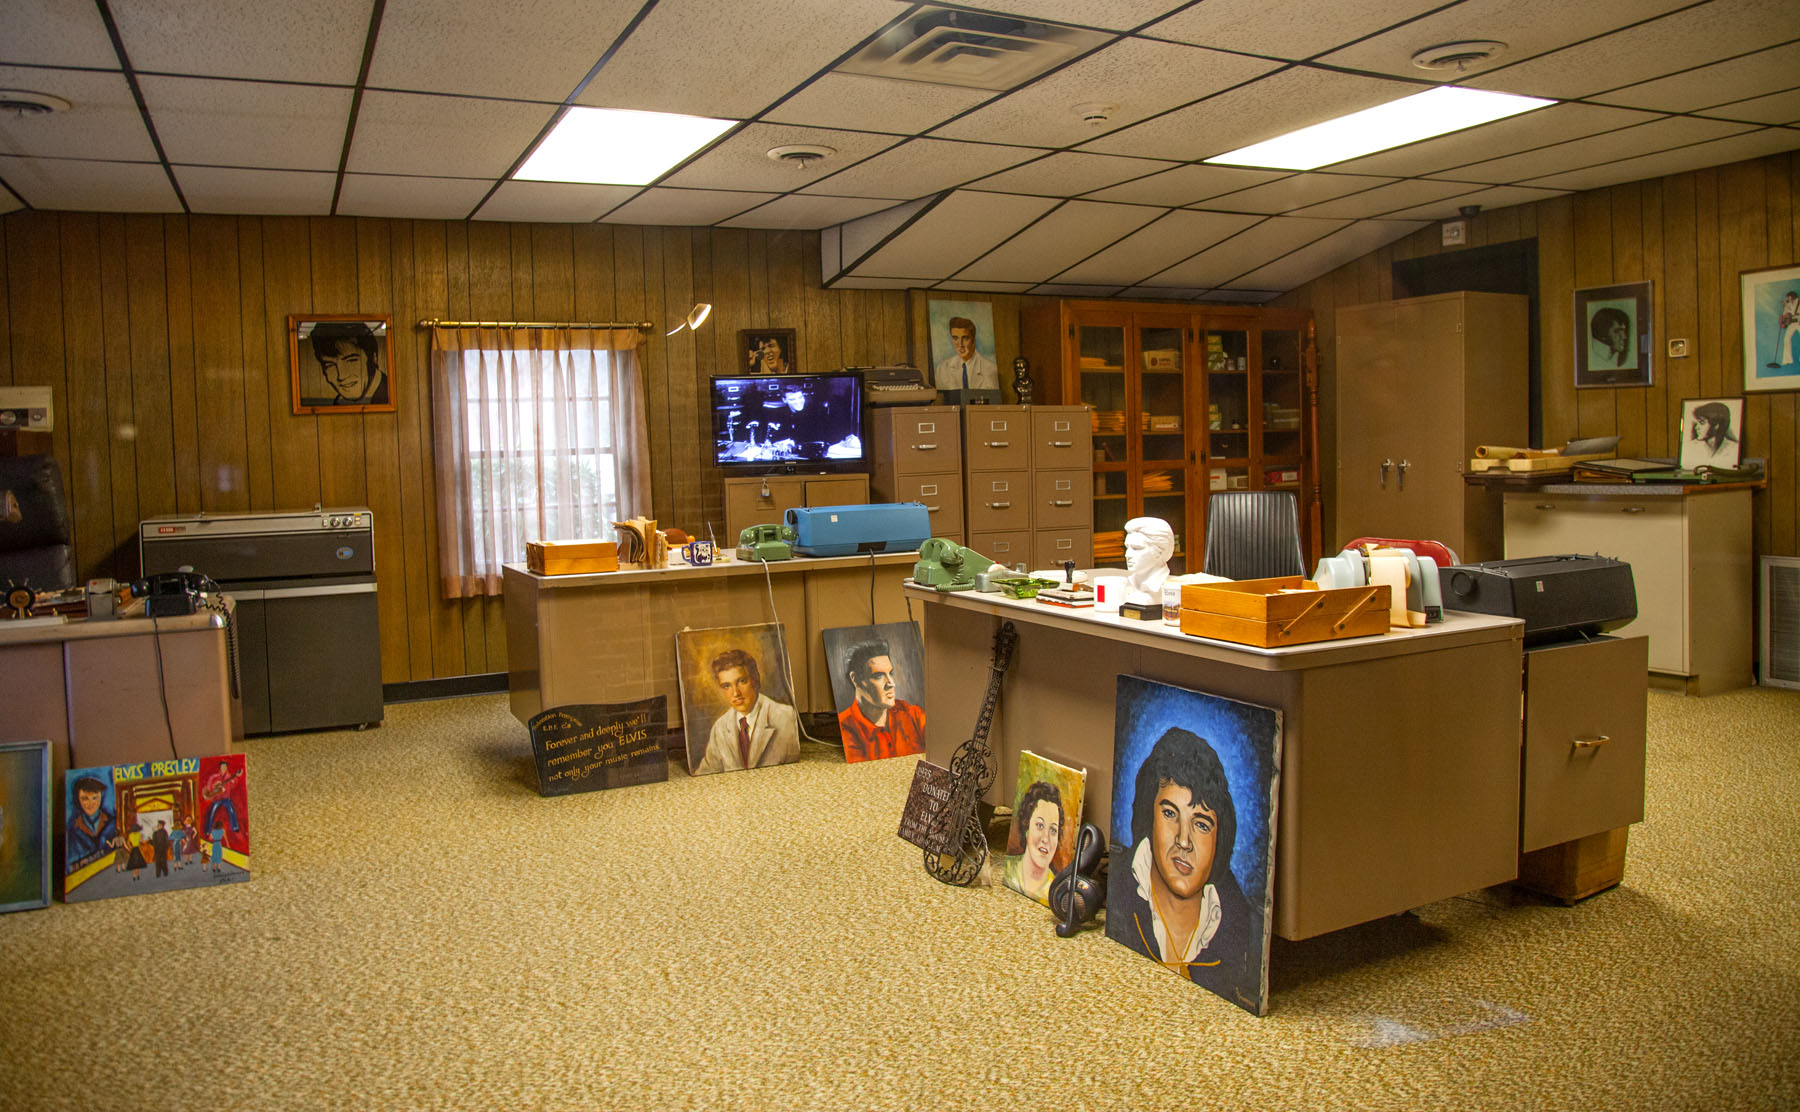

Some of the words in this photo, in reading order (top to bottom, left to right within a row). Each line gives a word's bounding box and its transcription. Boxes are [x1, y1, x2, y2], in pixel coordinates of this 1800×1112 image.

[545, 734, 578, 751] Forever
[580, 728, 594, 741] and
[596, 721, 624, 738] deeply
[626, 713, 647, 727] we'll
[547, 747, 593, 767] remember
[594, 742, 614, 760] you
[618, 729, 647, 746] ELVIS
[115, 764, 144, 780] ELVIS
[151, 759, 196, 777] PRESLEY
[548, 771, 562, 782] not
[564, 766, 581, 781] only
[581, 760, 603, 778] your
[605, 754, 628, 766] music
[929, 800, 939, 812] TO
